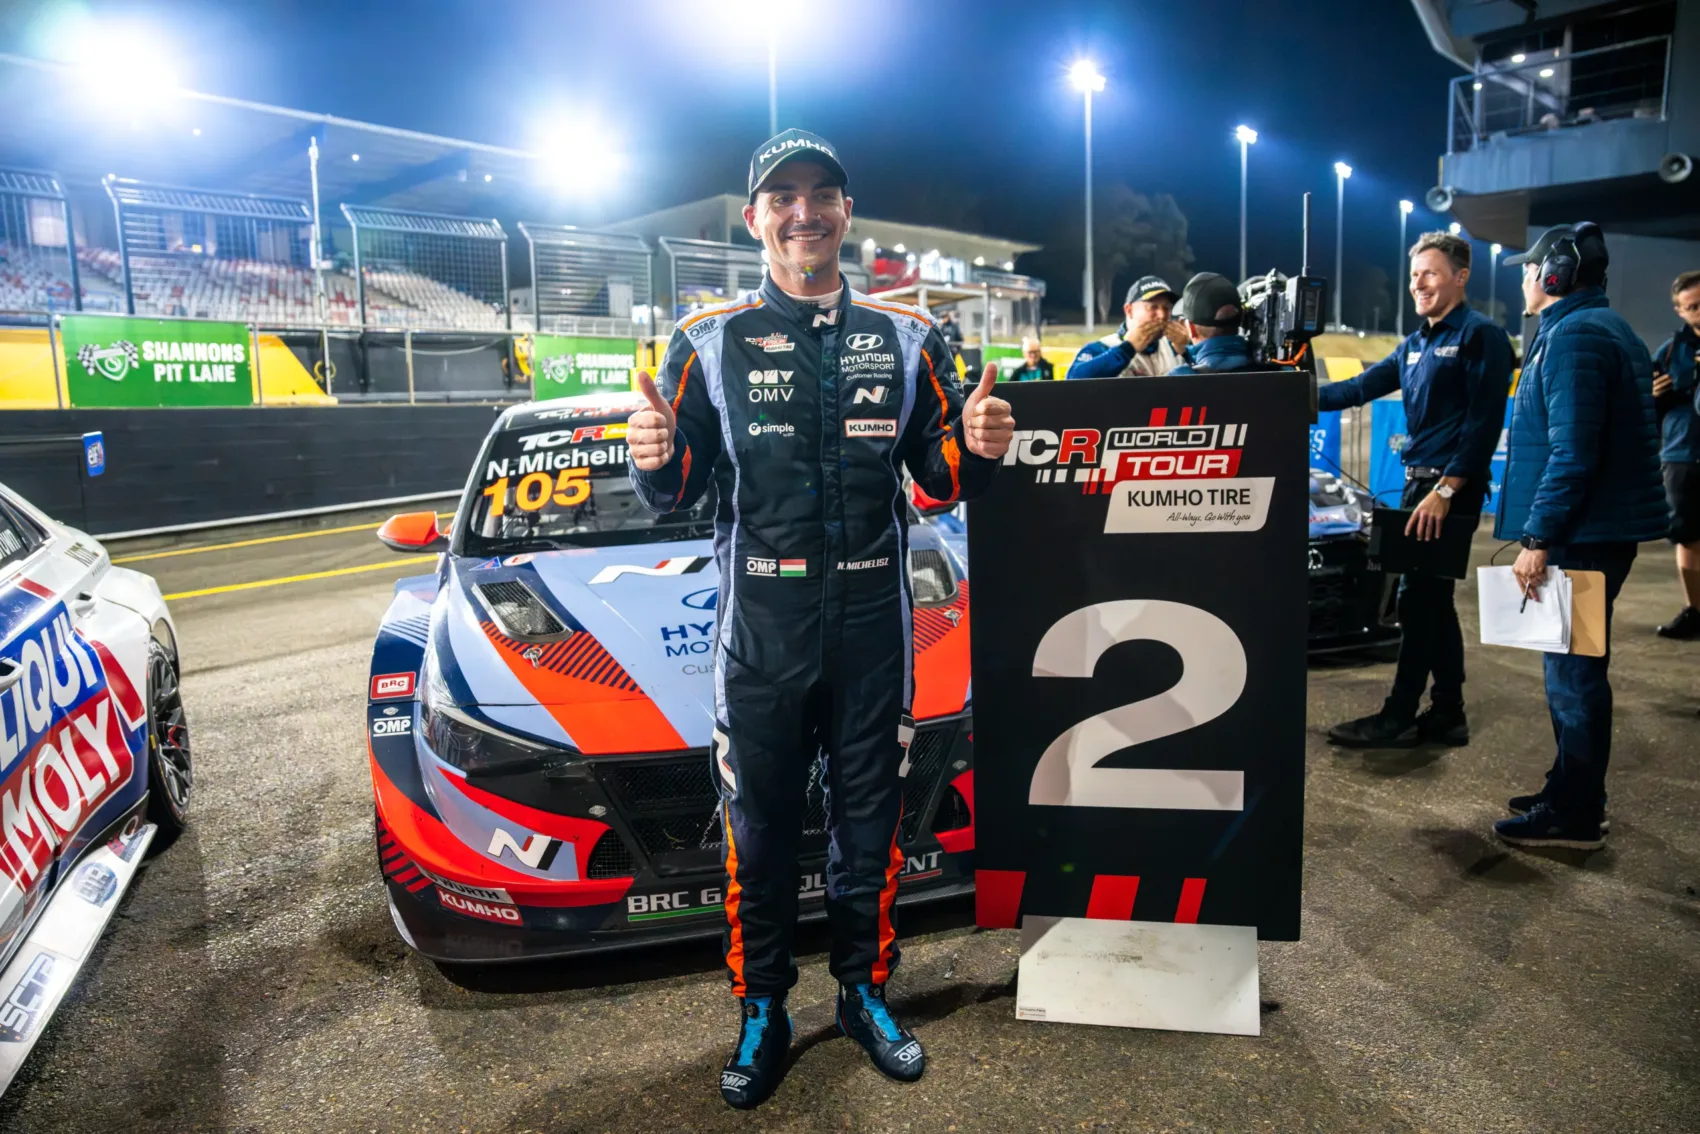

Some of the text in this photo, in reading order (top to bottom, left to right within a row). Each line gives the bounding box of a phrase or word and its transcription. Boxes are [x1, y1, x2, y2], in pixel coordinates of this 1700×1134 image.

[760, 139, 833, 164] KUMHO
[690, 319, 717, 337] OMP
[142, 341, 245, 362] SHANNONS
[840, 353, 895, 365] HYUNDAI
[154, 363, 236, 382] PIT LANE
[581, 370, 628, 384] PIT LANE
[841, 363, 895, 373] MOTORSPORT
[749, 388, 794, 403] OMV
[762, 423, 795, 434] simple
[849, 424, 893, 432] KUMHO
[518, 425, 606, 451] TCR
[1003, 429, 1206, 466] TCR WORLD
[1126, 454, 1229, 477] TOUR
[483, 467, 591, 517] 105
[1127, 488, 1250, 507] KUMHO TIRE
[747, 561, 776, 573] OMP
[837, 558, 889, 570] N.MICHELISZ
[0, 612, 97, 771] LIQUI
[381, 680, 405, 689] BRC
[1028, 599, 1247, 811] 2
[373, 719, 411, 734] OMP
[3, 697, 120, 888] MOLY
[439, 891, 519, 920] KUMHO
[627, 891, 689, 913] BRC
[701, 888, 723, 905] G
[899, 1043, 922, 1062] OMP
[720, 1074, 748, 1088] OMP
